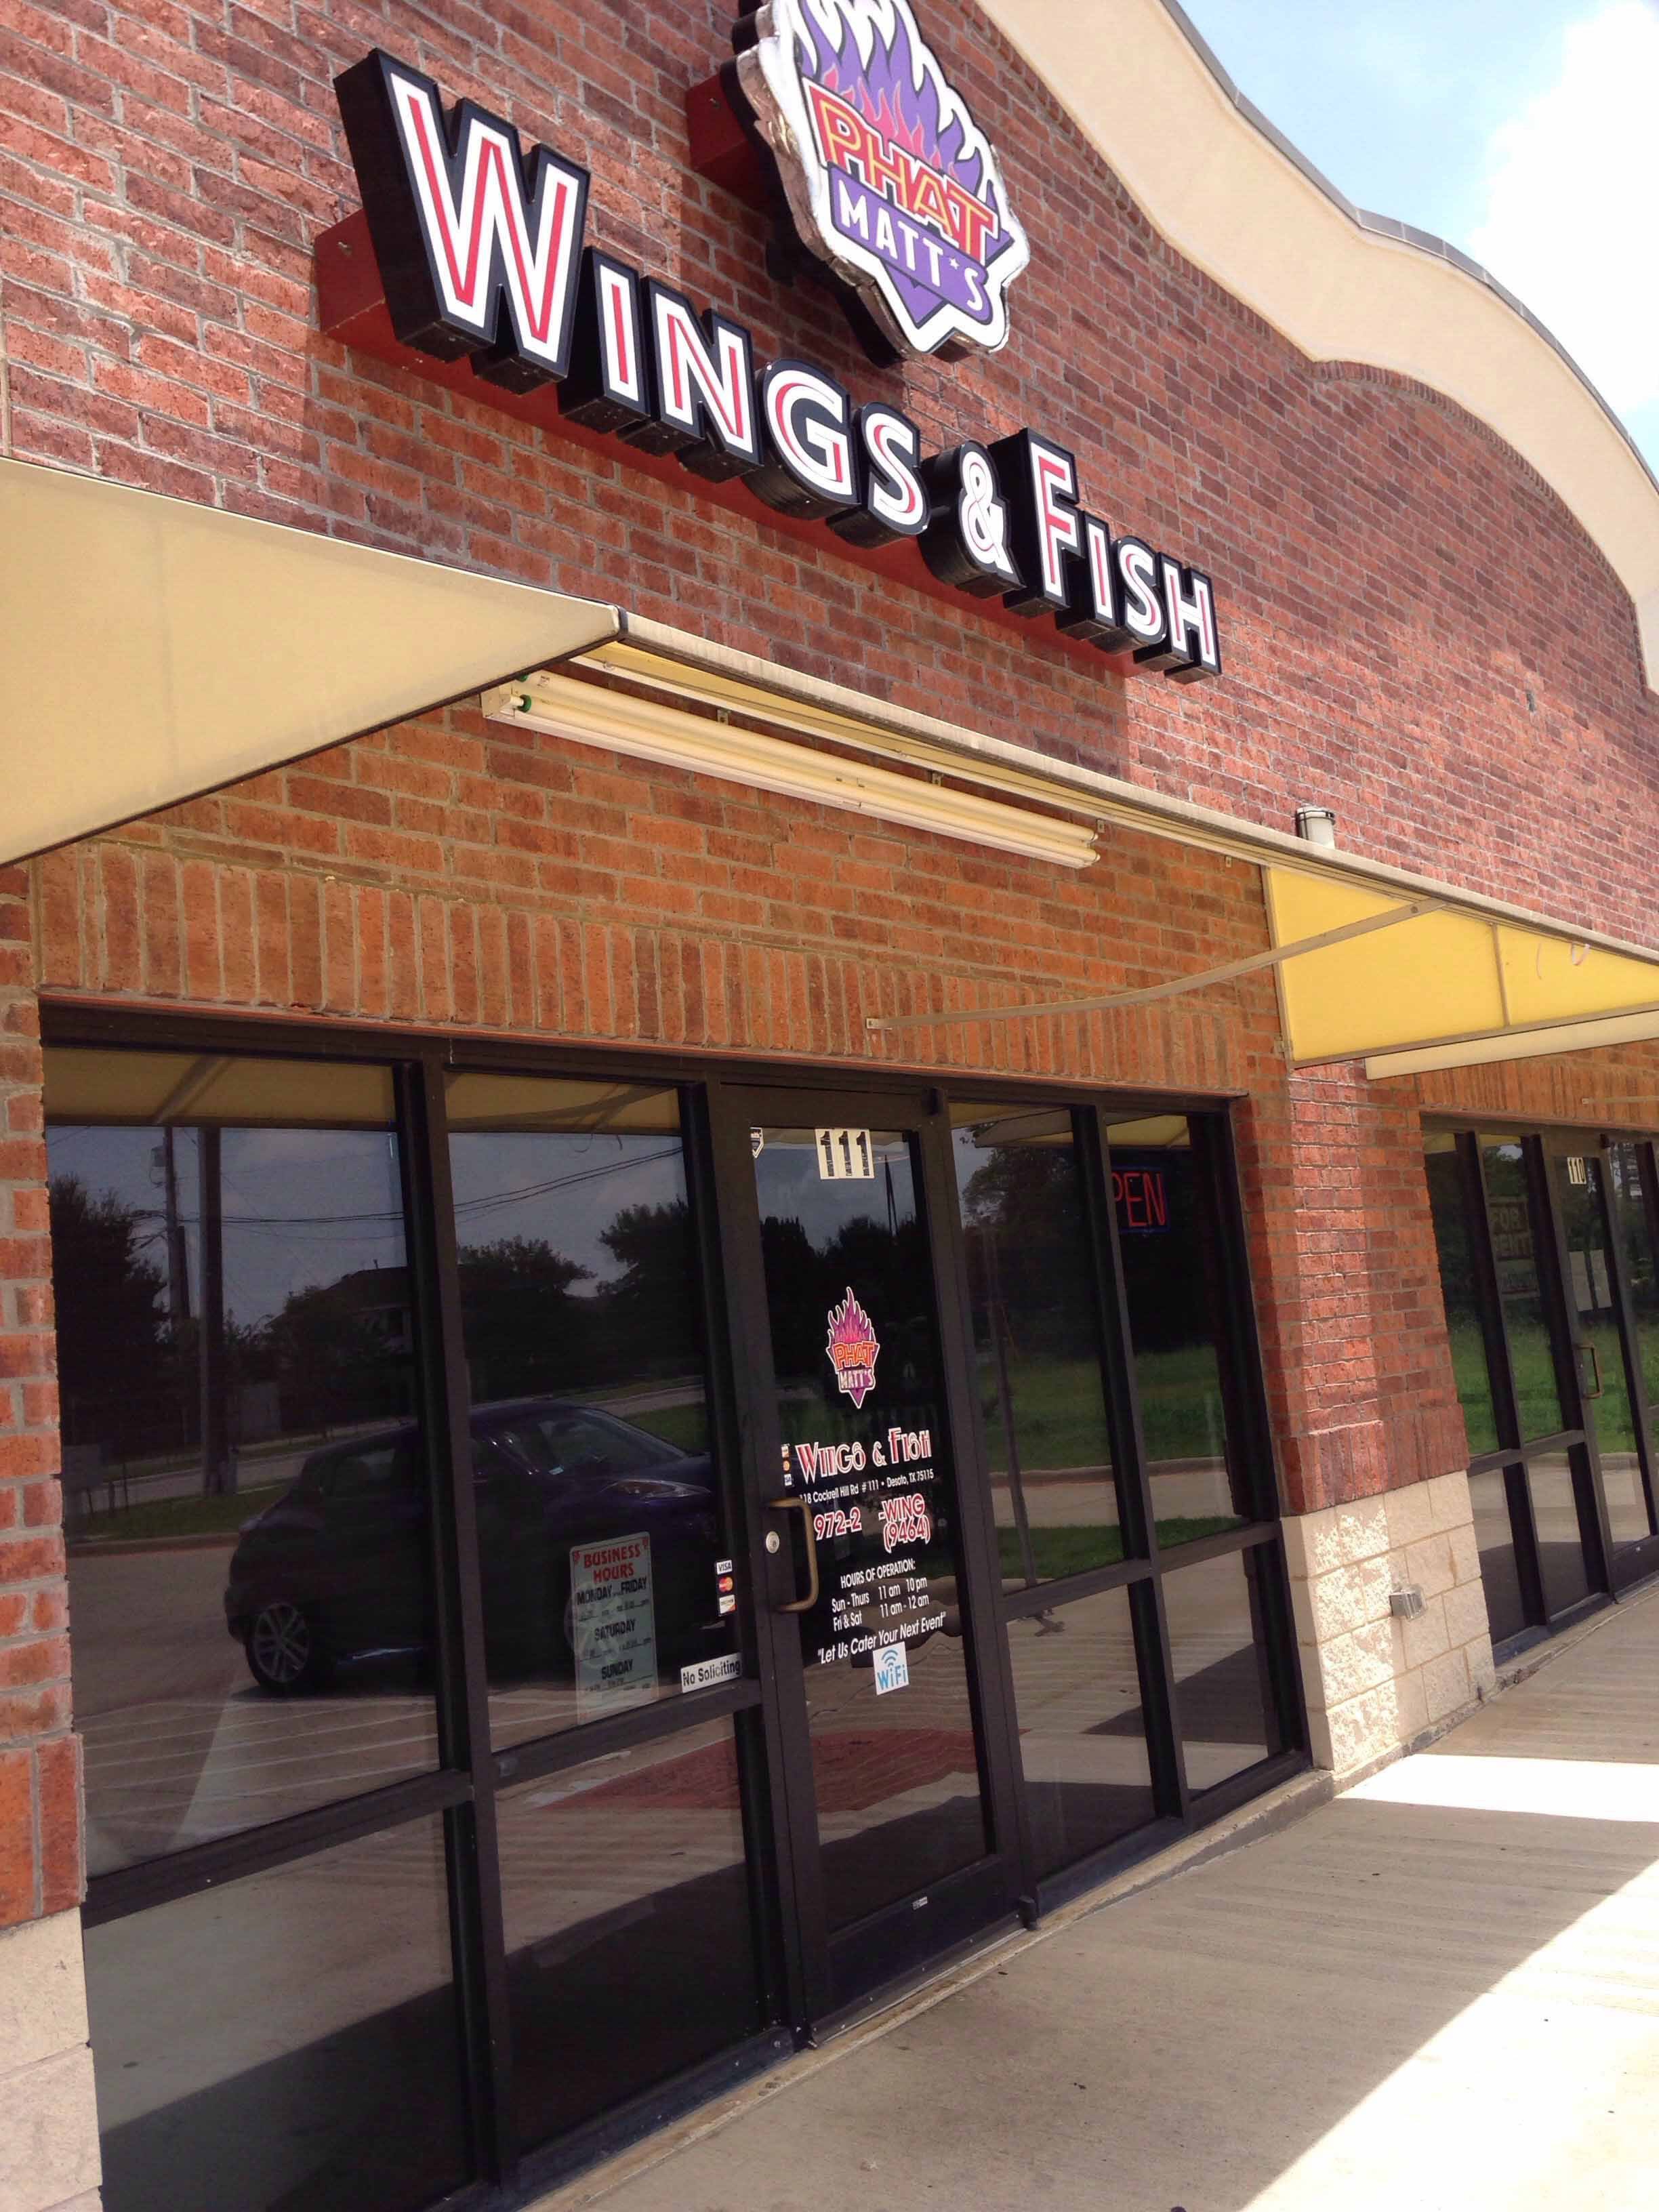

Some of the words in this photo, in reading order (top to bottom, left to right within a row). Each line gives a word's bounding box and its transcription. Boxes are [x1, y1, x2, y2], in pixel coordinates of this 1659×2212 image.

[802, 78, 999, 266] PHAT
[838, 179, 983, 311] MATT'S
[384, 65, 926, 529] WINGS
[957, 449, 1023, 576] &
[1027, 438, 1218, 672] FISH
[820, 1130, 870, 1177] 111
[832, 1340, 875, 1371] PHAT
[839, 1368, 874, 1389] MATT'S
[872, 1440, 887, 1467] &
[840, 1485, 850, 1498] Hill
[850, 1483, 859, 1495] Rd
[868, 1479, 879, 1491] 111
[909, 1472, 917, 1483] TX
[916, 1469, 934, 1482] 75115
[813, 1507, 862, 1541] 972-2
[883, 1514, 932, 1553] (9464)
[584, 1544, 640, 1568] BUSINESS
[718, 1561, 731, 1572] VISA
[594, 1562, 634, 1584] HOURS
[840, 1574, 865, 1589] HOURS
[865, 1568, 876, 1582] OF
[876, 1558, 916, 1579] OPERATION:
[577, 1584, 613, 1605] MONDAY
[621, 1575, 647, 1594] FRIDAY
[832, 1597, 846, 1613] Sun
[851, 1591, 869, 1607] Thurs
[878, 1586, 887, 1600] 11
[888, 1584, 901, 1597] am
[906, 1578, 915, 1592] 10
[916, 1576, 928, 1593] pm
[833, 1616, 843, 1632] Fri
[843, 1616, 850, 1629] &
[851, 1610, 863, 1627] Sat
[880, 1604, 889, 1618] 11
[890, 1603, 903, 1616] am
[908, 1596, 917, 1610] 12
[918, 1594, 930, 1607] am
[594, 1618, 636, 1641] SATURDAY
[838, 1642, 848, 1659] Us
[851, 1635, 877, 1655] Cater
[878, 1629, 899, 1646] Your
[900, 1622, 920, 1639] Next
[602, 1659, 634, 1680] SUNDAY
[682, 1671, 695, 1687] No
[698, 1660, 741, 1682] Soliciting
[877, 1664, 908, 1690] WiFi
